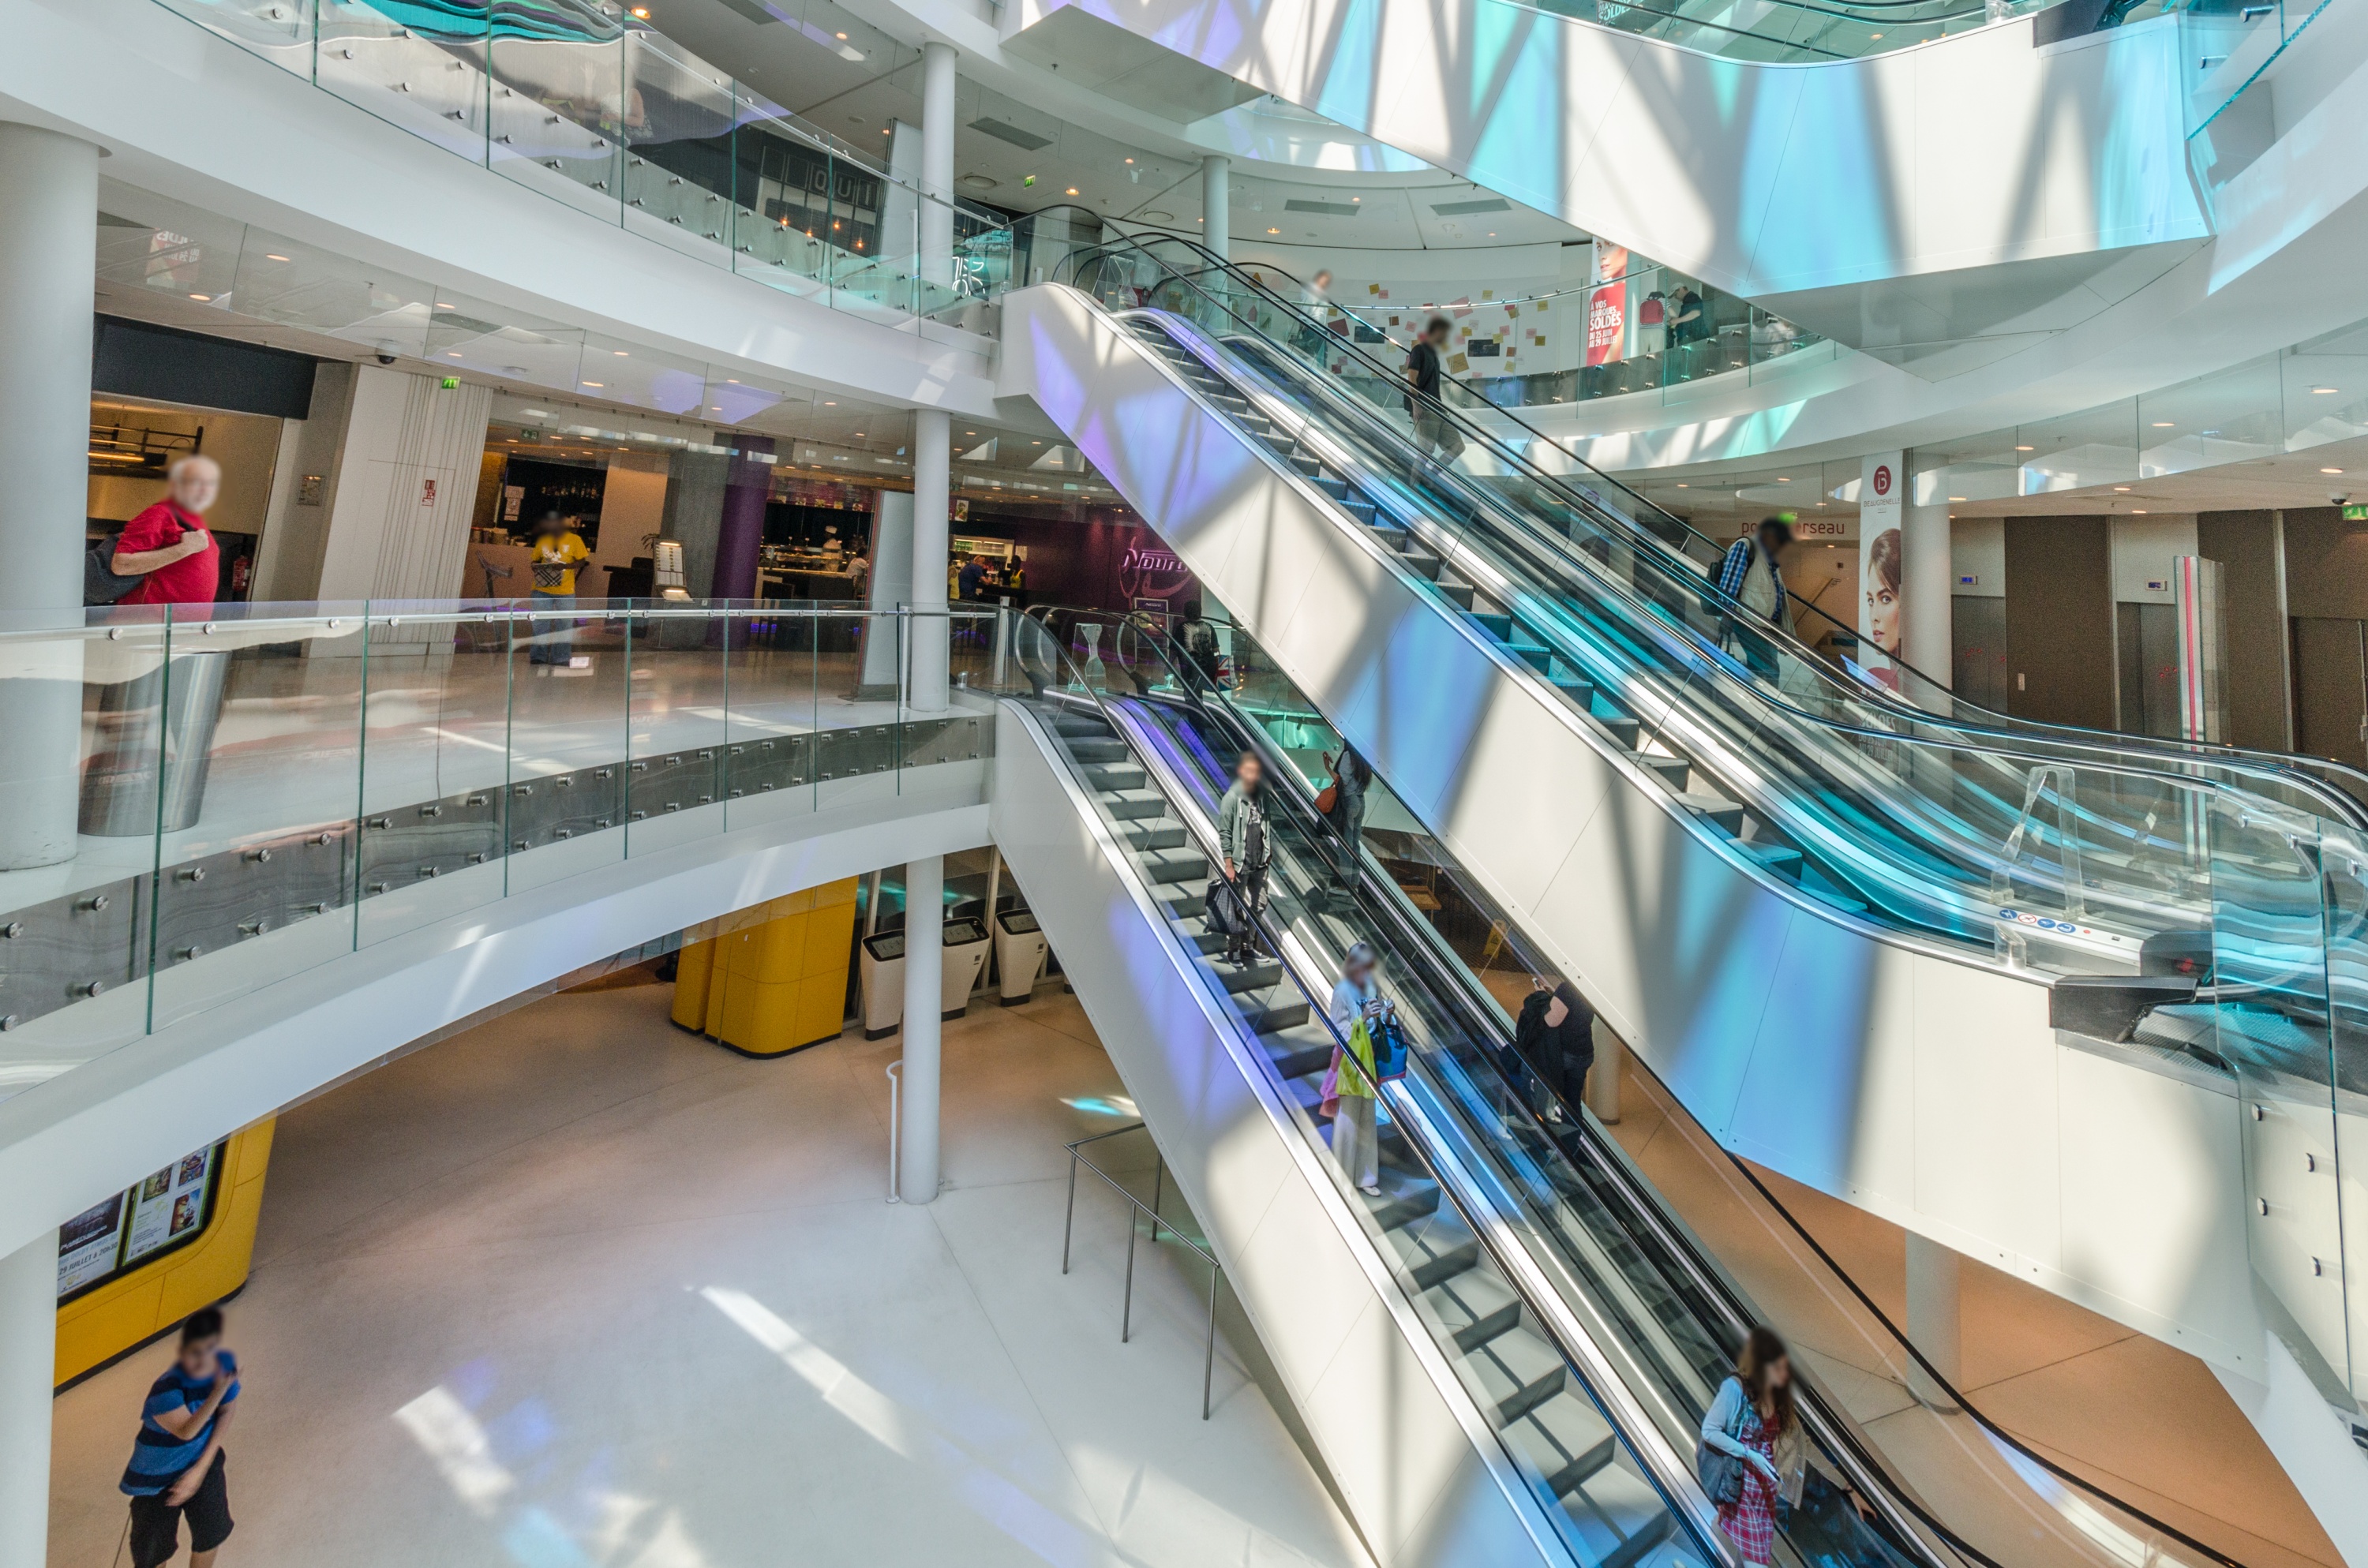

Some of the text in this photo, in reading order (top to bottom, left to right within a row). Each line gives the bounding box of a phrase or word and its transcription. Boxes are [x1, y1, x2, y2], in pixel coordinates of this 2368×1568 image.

[1595, 300, 1606, 309] VOS
[1590, 312, 1621, 331] SOLDES
[1602, 328, 1613, 338] JUIN
[1595, 338, 1601, 346] 29
[1864, 497, 1901, 507] BEAUGRENELLE
[69, 1254, 92, 1270] JUILLET
